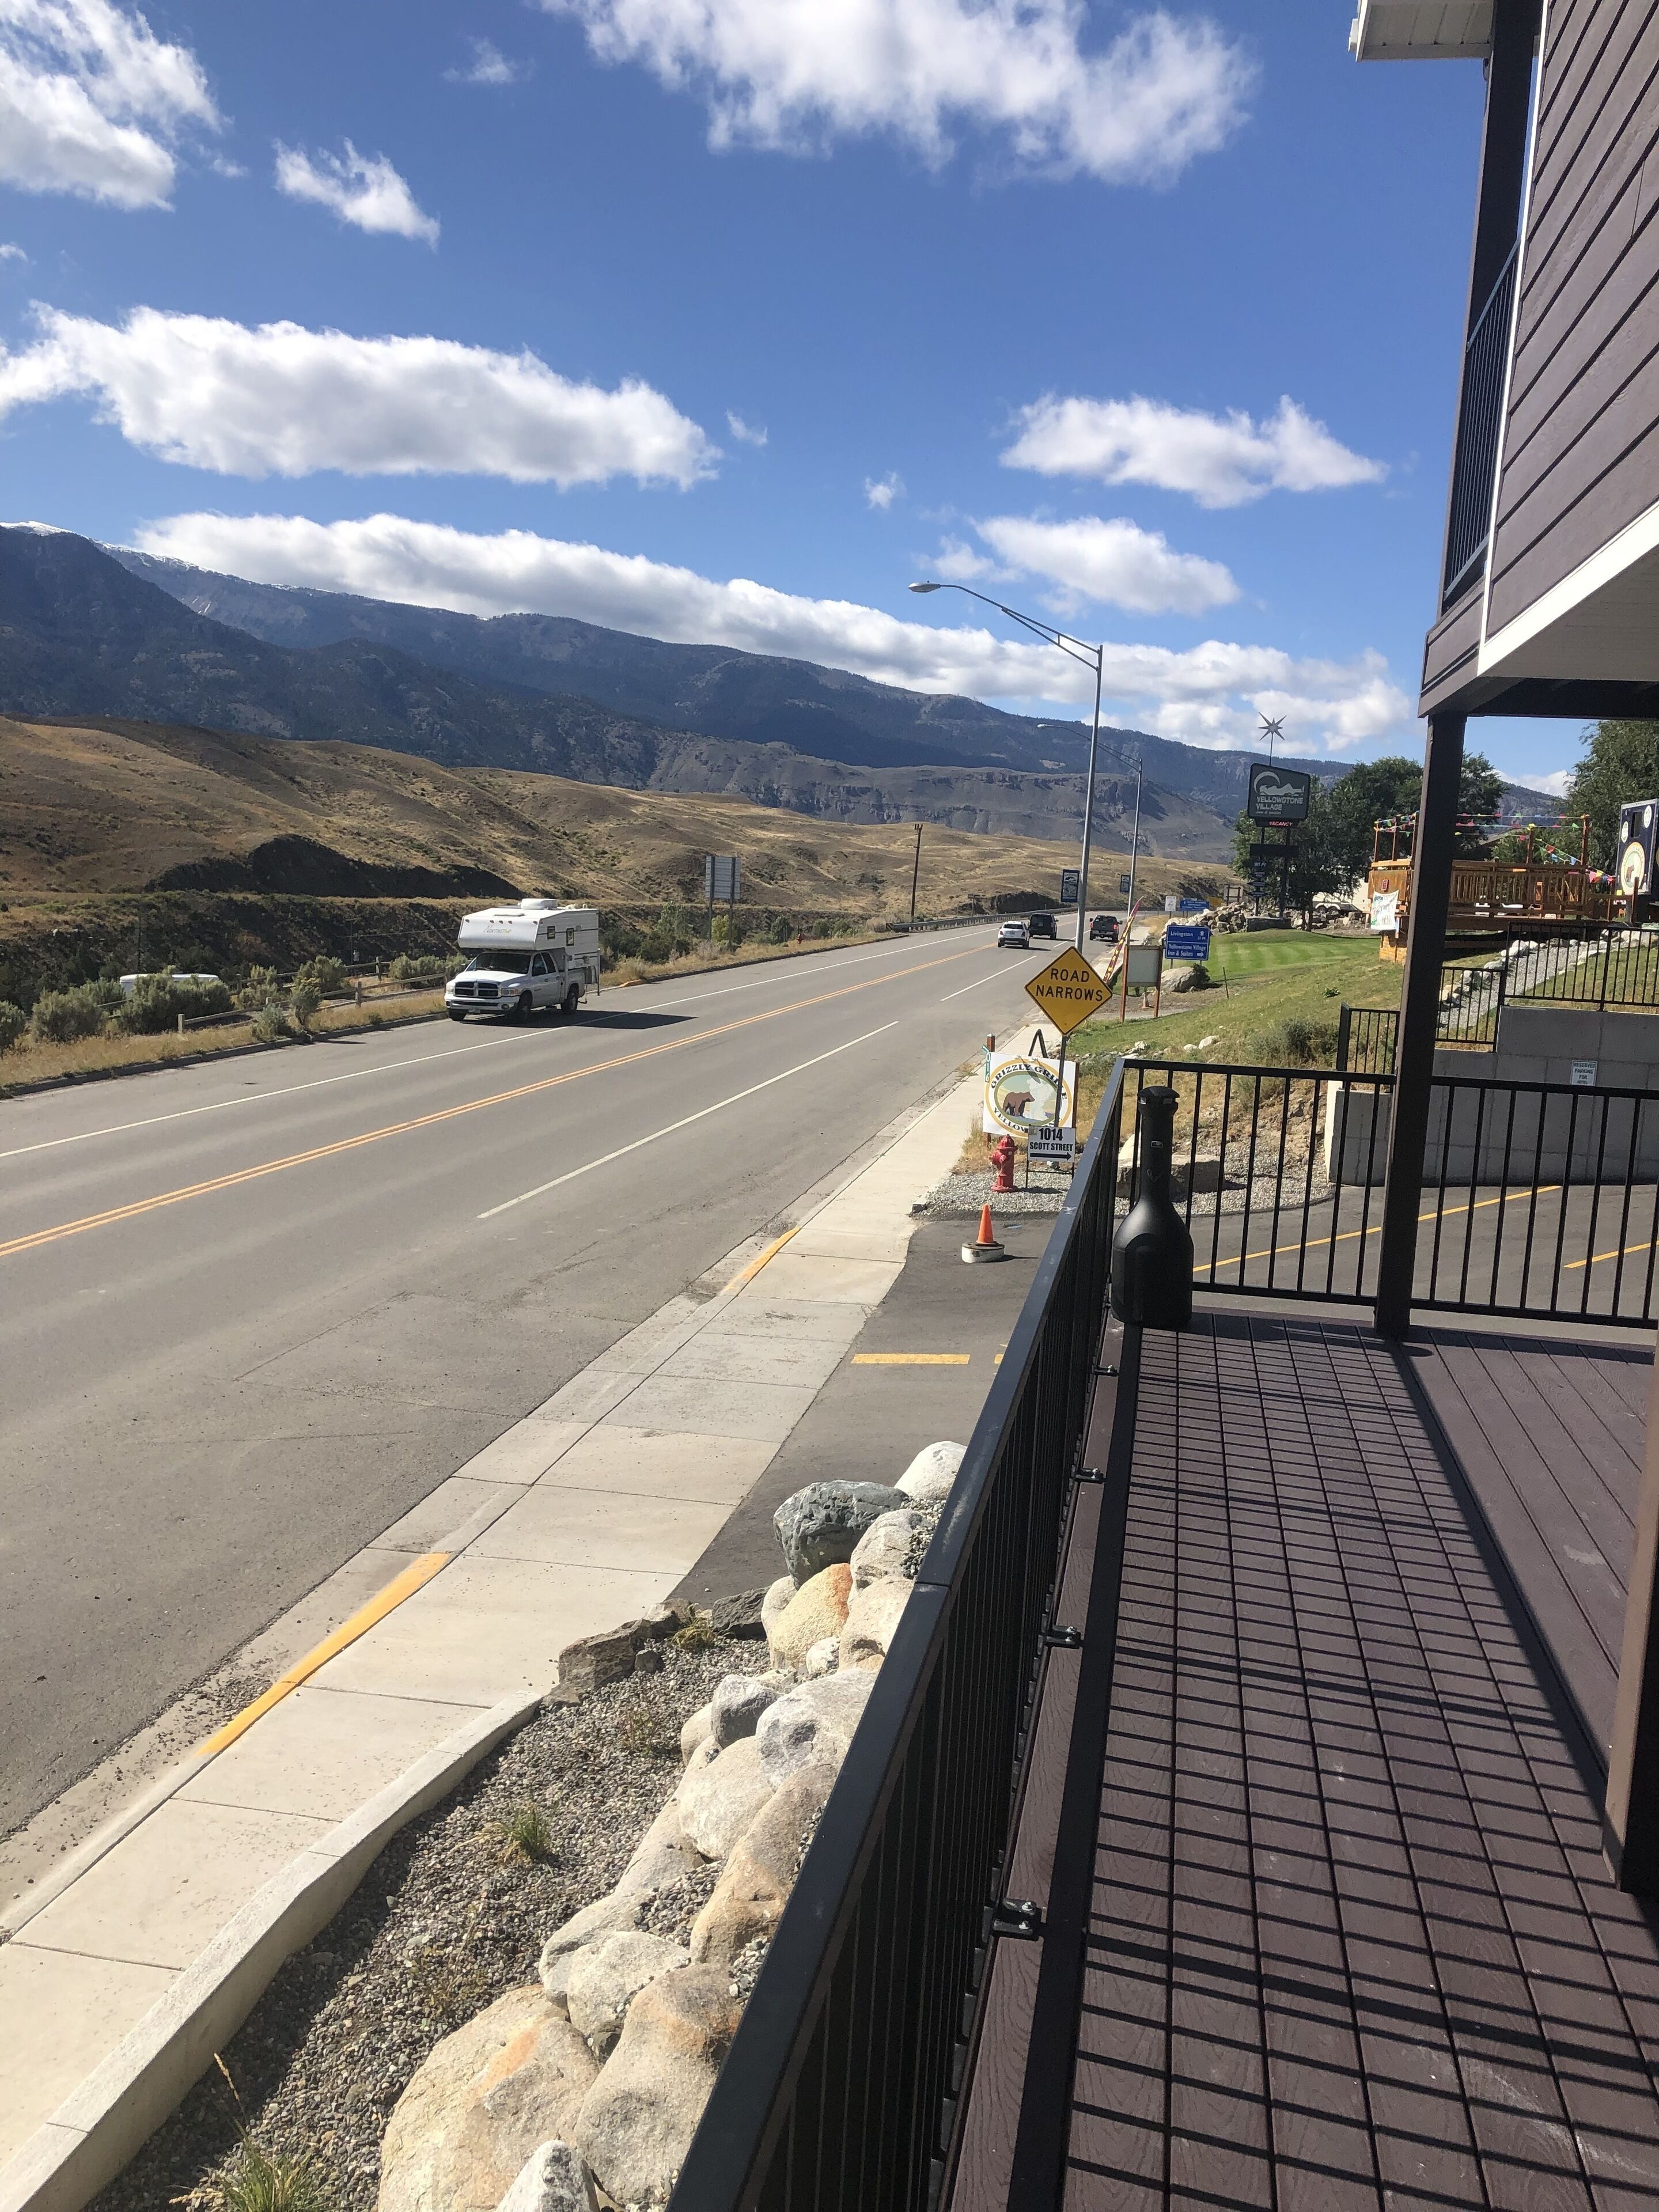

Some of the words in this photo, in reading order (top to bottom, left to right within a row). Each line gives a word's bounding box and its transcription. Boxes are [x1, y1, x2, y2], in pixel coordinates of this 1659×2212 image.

[1256, 796, 1304, 804] YELLOWSTONE
[1050, 968, 1089, 982] ROAD
[1036, 984, 1103, 1002] NARROWS
[991, 1064, 1031, 1089] GRIZZLY
[1039, 1127, 1063, 1141] 1014
[1029, 1142, 1050, 1150] SCOTT
[1051, 1142, 1074, 1152] STREET
